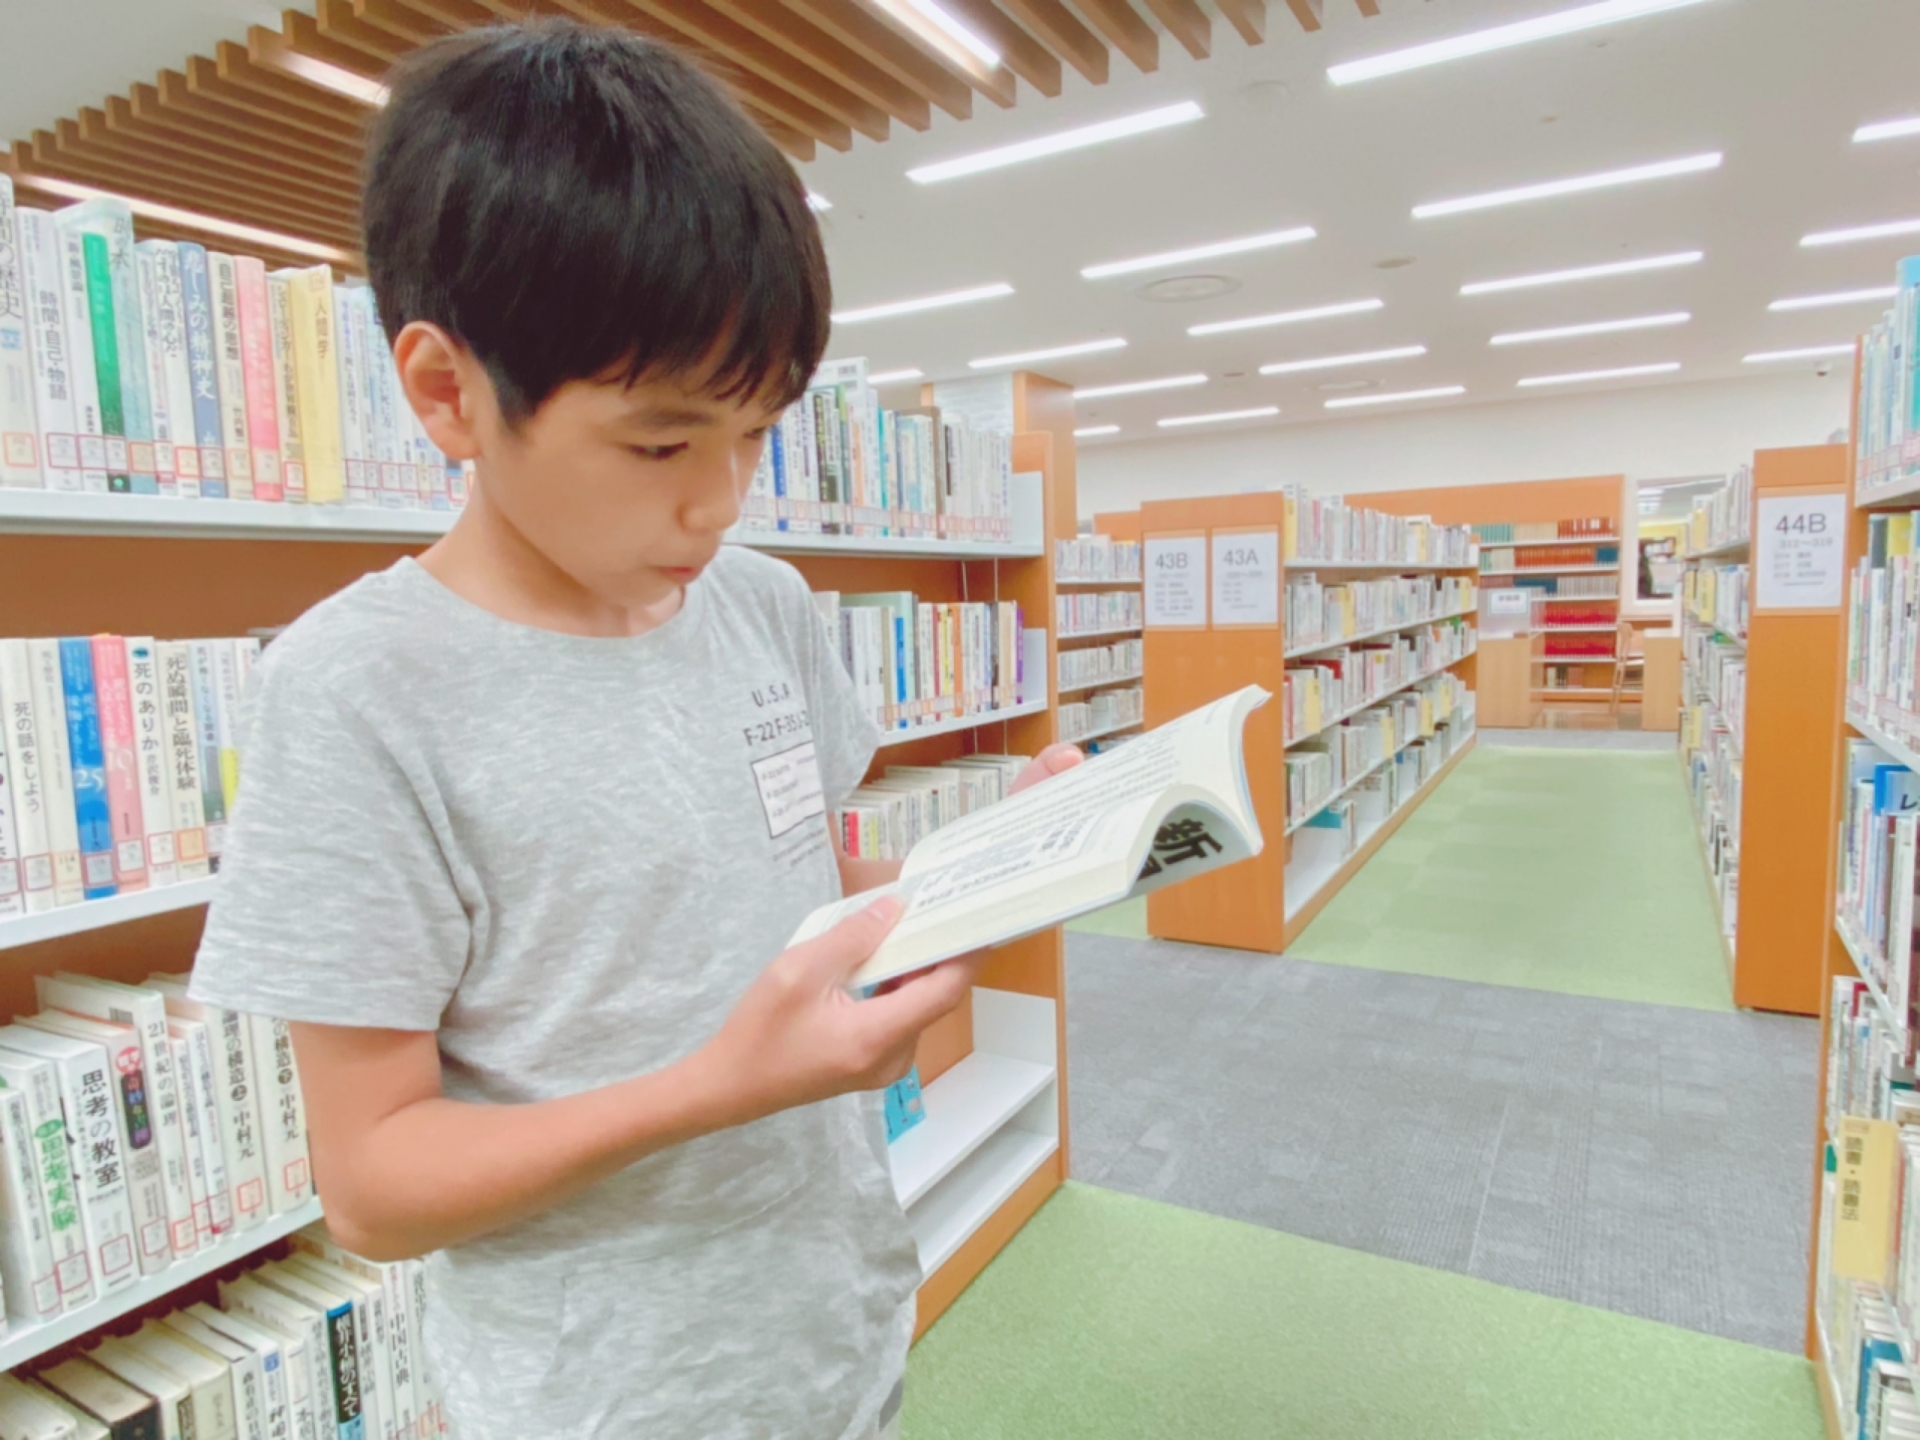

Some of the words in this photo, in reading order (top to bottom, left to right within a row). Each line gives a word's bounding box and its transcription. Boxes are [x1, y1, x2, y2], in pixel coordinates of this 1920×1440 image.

[1775, 513, 1828, 535] 44B
[1154, 552, 1189, 570] 43B
[1222, 549, 1260, 567] 43A
[134, 663, 160, 751] 死のありか
[166, 655, 197, 791] 死ぬ瞬間と臨死体験
[14, 701, 40, 814] 死の話をしよう
[75, 768, 105, 793] 25
[271, 1017, 292, 1069] の構造
[81, 1068, 122, 1190] 思考の教室
[389, 1312, 409, 1388] 中国古典
